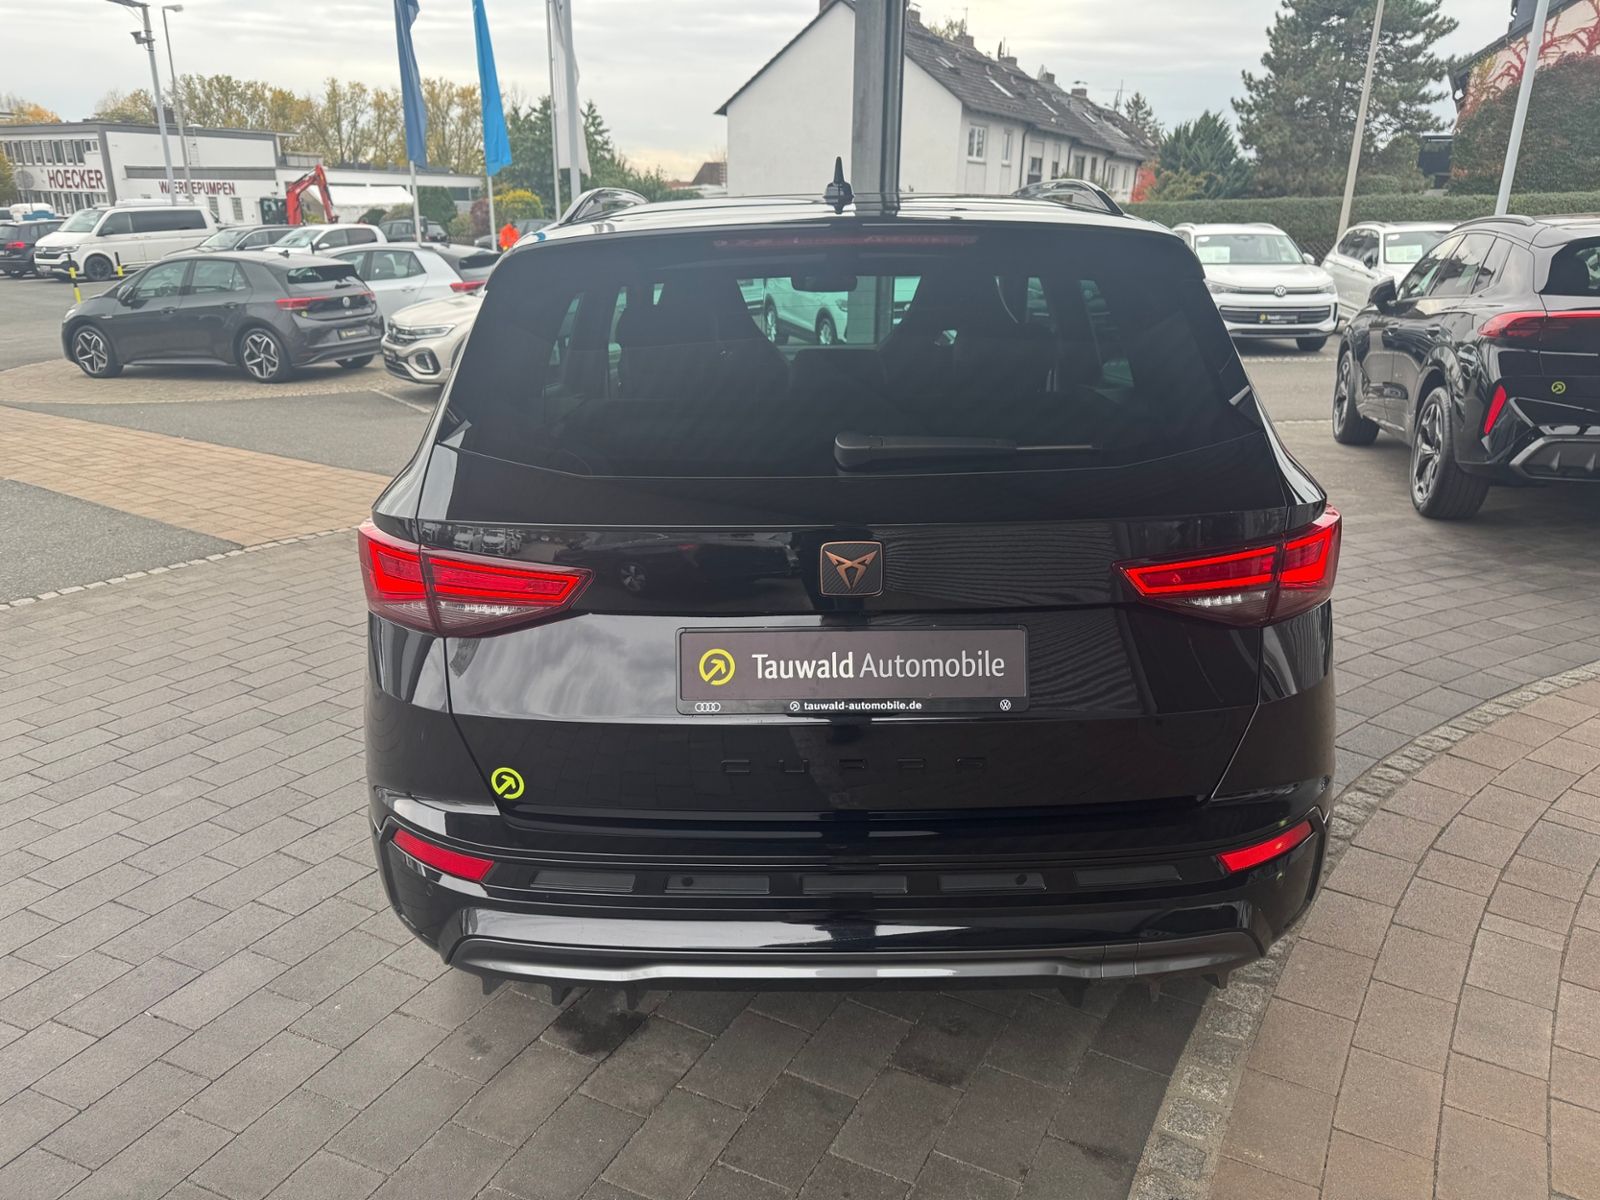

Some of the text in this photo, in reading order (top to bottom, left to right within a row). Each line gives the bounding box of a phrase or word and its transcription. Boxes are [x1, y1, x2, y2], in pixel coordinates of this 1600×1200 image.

[47, 169, 105, 189] HOECKER
[158, 180, 236, 196] WEREPUMPEN
[752, 650, 1005, 679] Tauwald Automobile
[803, 701, 922, 711] tauwald-automobile.de
